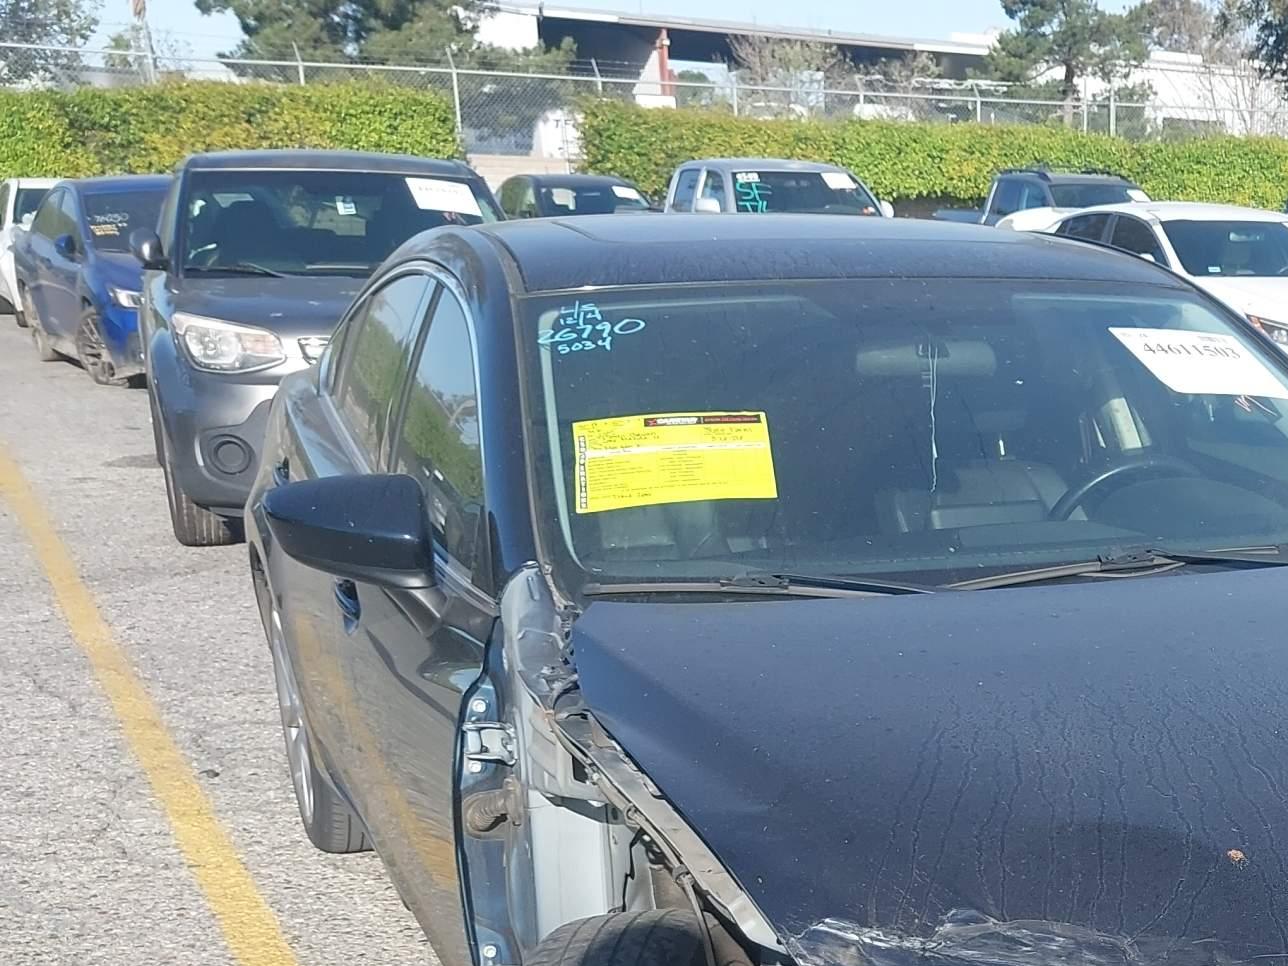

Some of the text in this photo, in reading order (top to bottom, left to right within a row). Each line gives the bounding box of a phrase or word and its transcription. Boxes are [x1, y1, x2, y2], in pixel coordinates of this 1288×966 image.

[537, 318, 646, 344] 26790
[557, 336, 613, 355] 5034
[1143, 342, 1241, 360] 44611503
